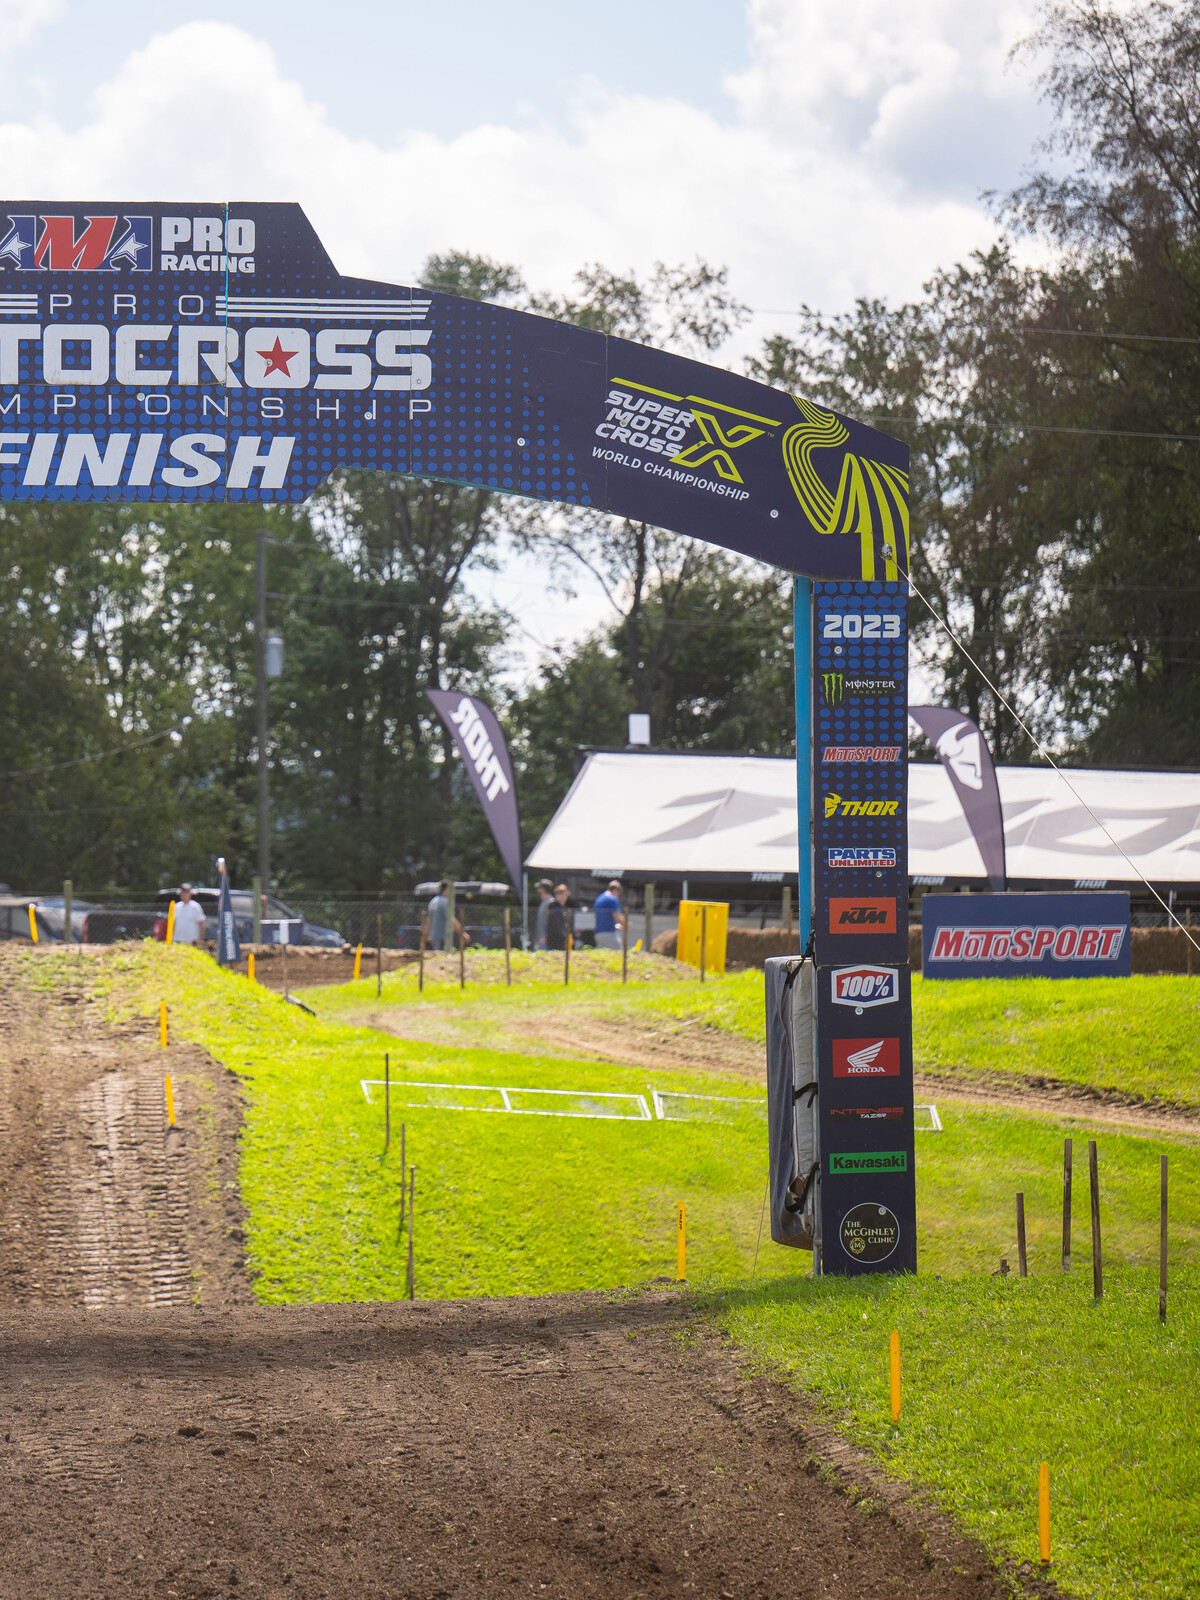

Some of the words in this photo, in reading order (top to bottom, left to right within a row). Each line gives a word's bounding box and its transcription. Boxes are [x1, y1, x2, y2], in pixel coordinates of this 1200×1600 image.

[161, 217, 255, 253] PRO
[161, 254, 255, 273] RACING
[50, 294, 204, 316] PRO
[604, 390, 695, 428] SUPER
[605, 408, 686, 442] MOTO
[595, 422, 683, 458] CROSS
[591, 446, 642, 469] WORLD
[643, 462, 750, 501] CHAMPIONSHIP
[823, 614, 900, 638] 2023
[845, 679, 895, 689] MONSTER
[840, 801, 899, 816] THOR
[829, 849, 895, 859] PARTS
[838, 907, 887, 924] KTM
[840, 975, 890, 997] 100%
[833, 1155, 905, 1169] Kawasaki
